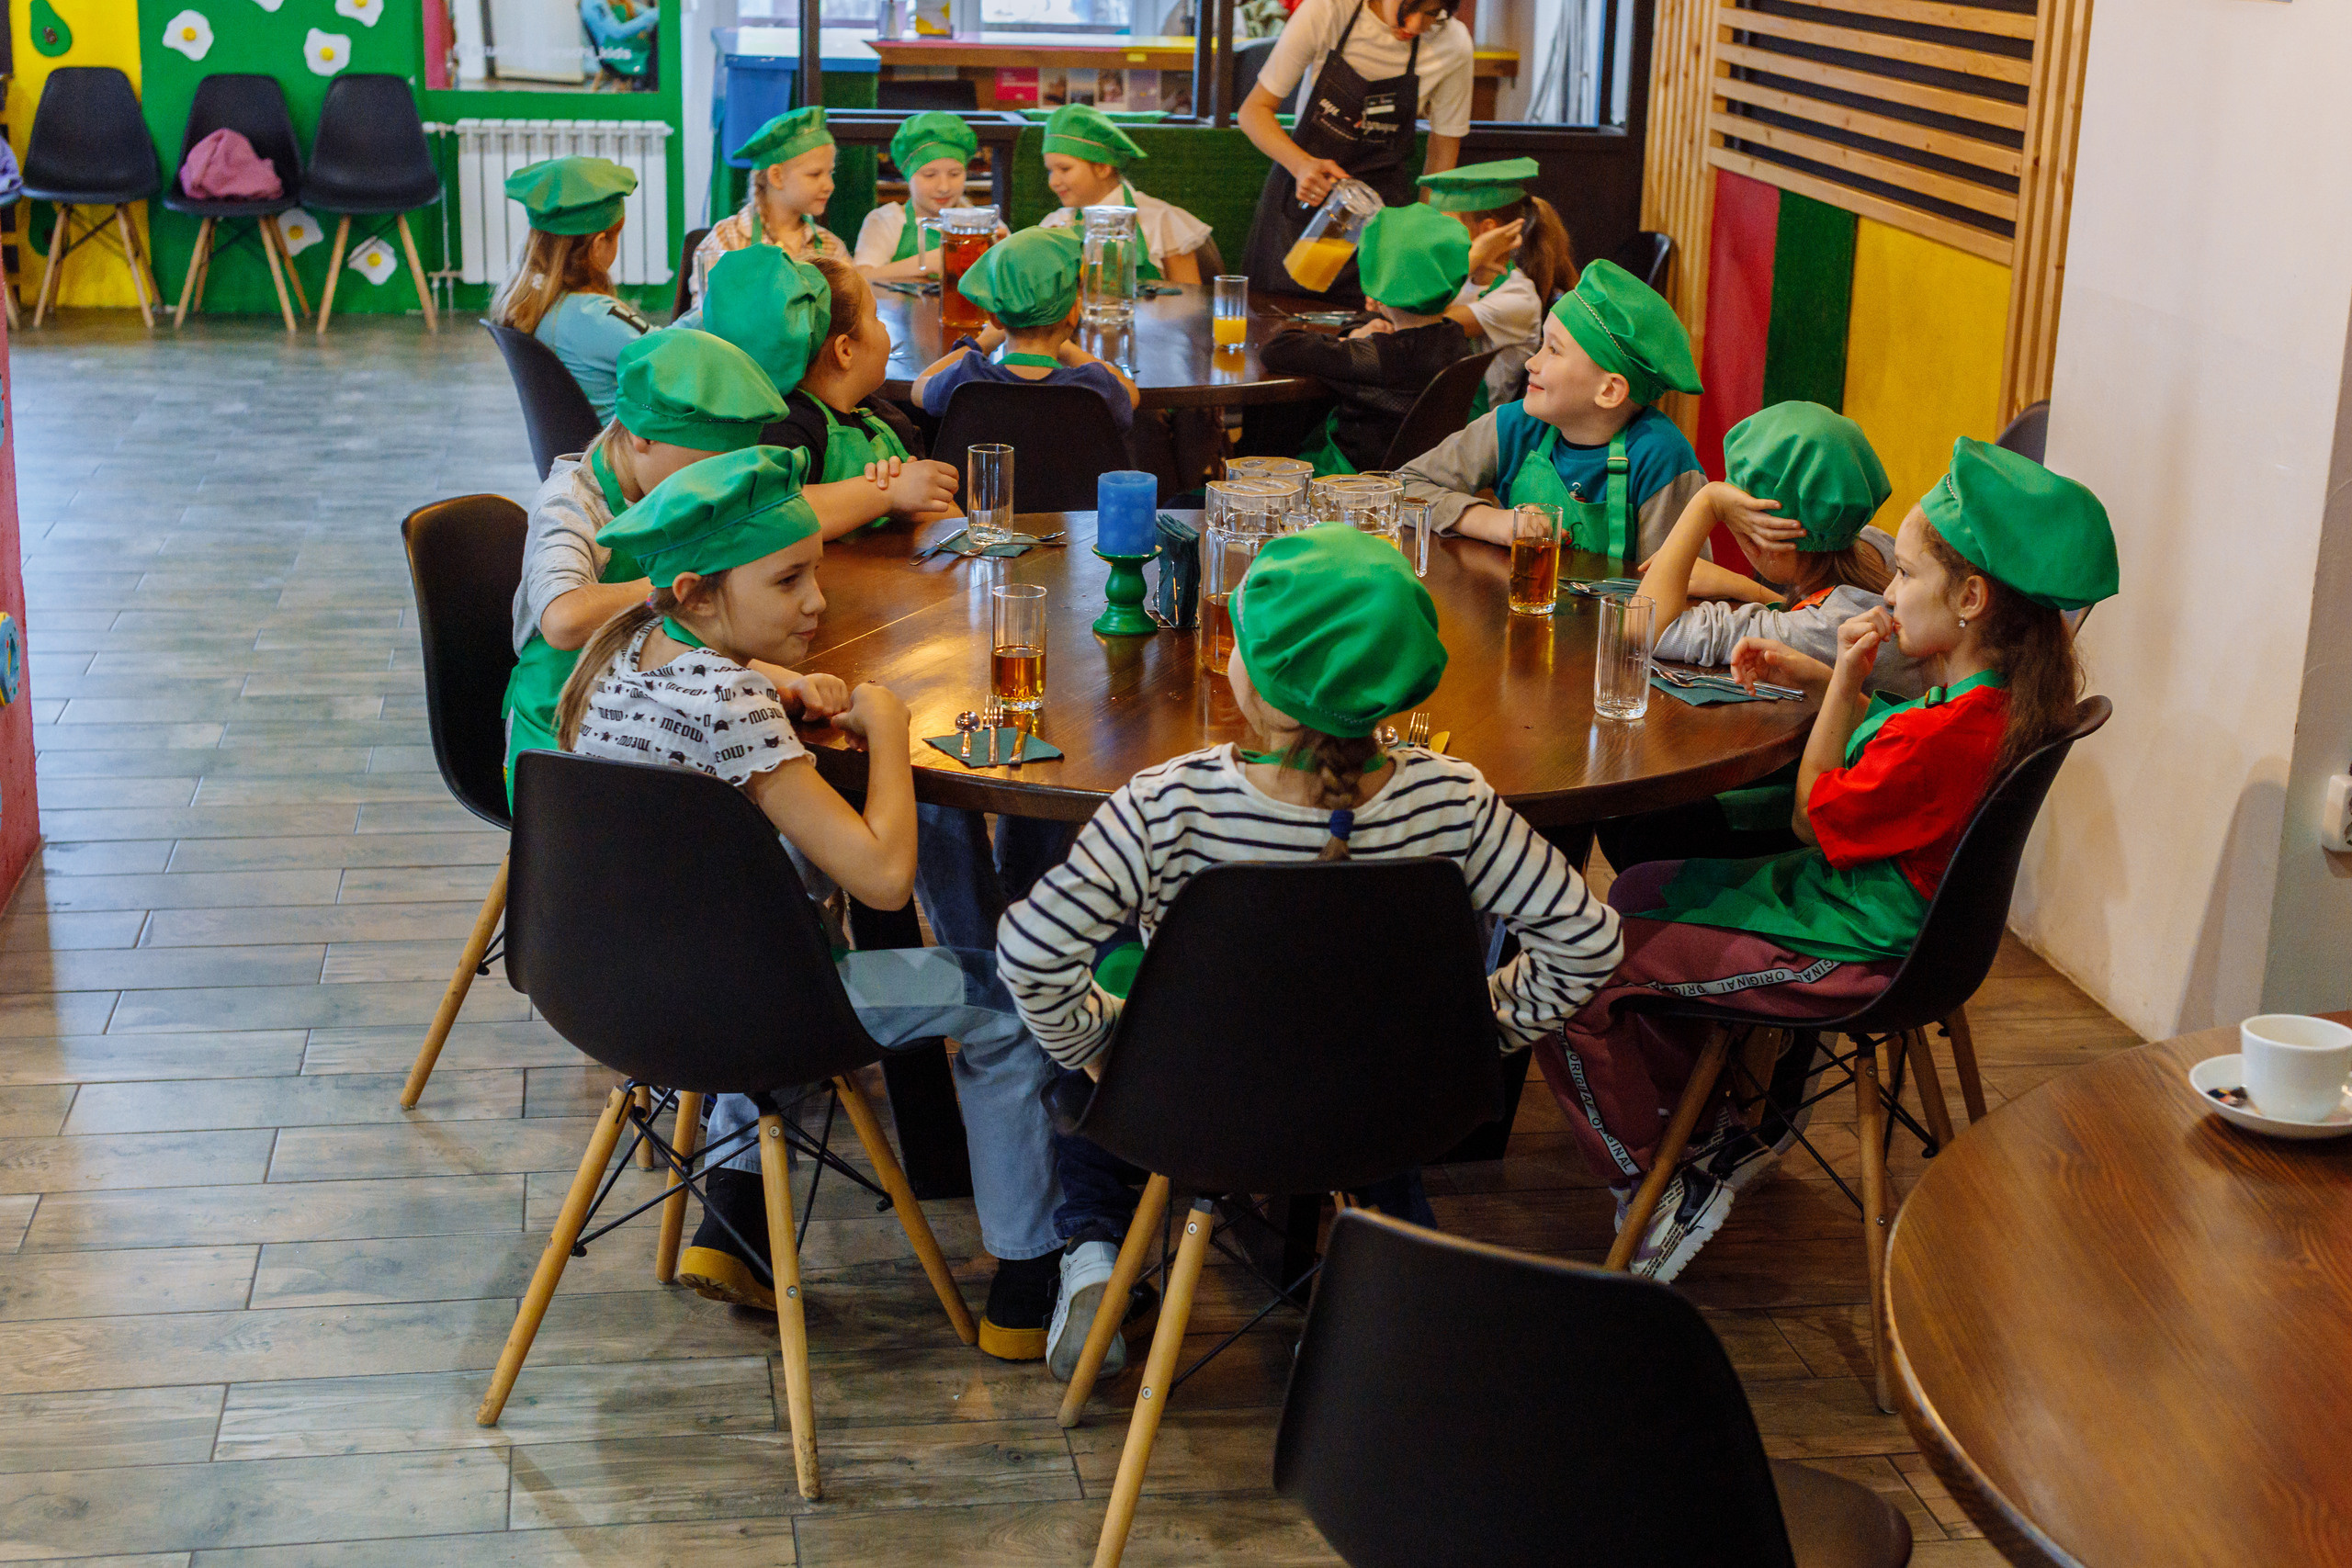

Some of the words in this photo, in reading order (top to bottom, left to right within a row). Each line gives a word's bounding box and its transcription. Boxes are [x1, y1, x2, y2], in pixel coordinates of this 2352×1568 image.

[659, 716, 704, 742] MEOW
[616, 735, 652, 752] MEOW
[1717, 970, 1786, 992] ORIGINAL
